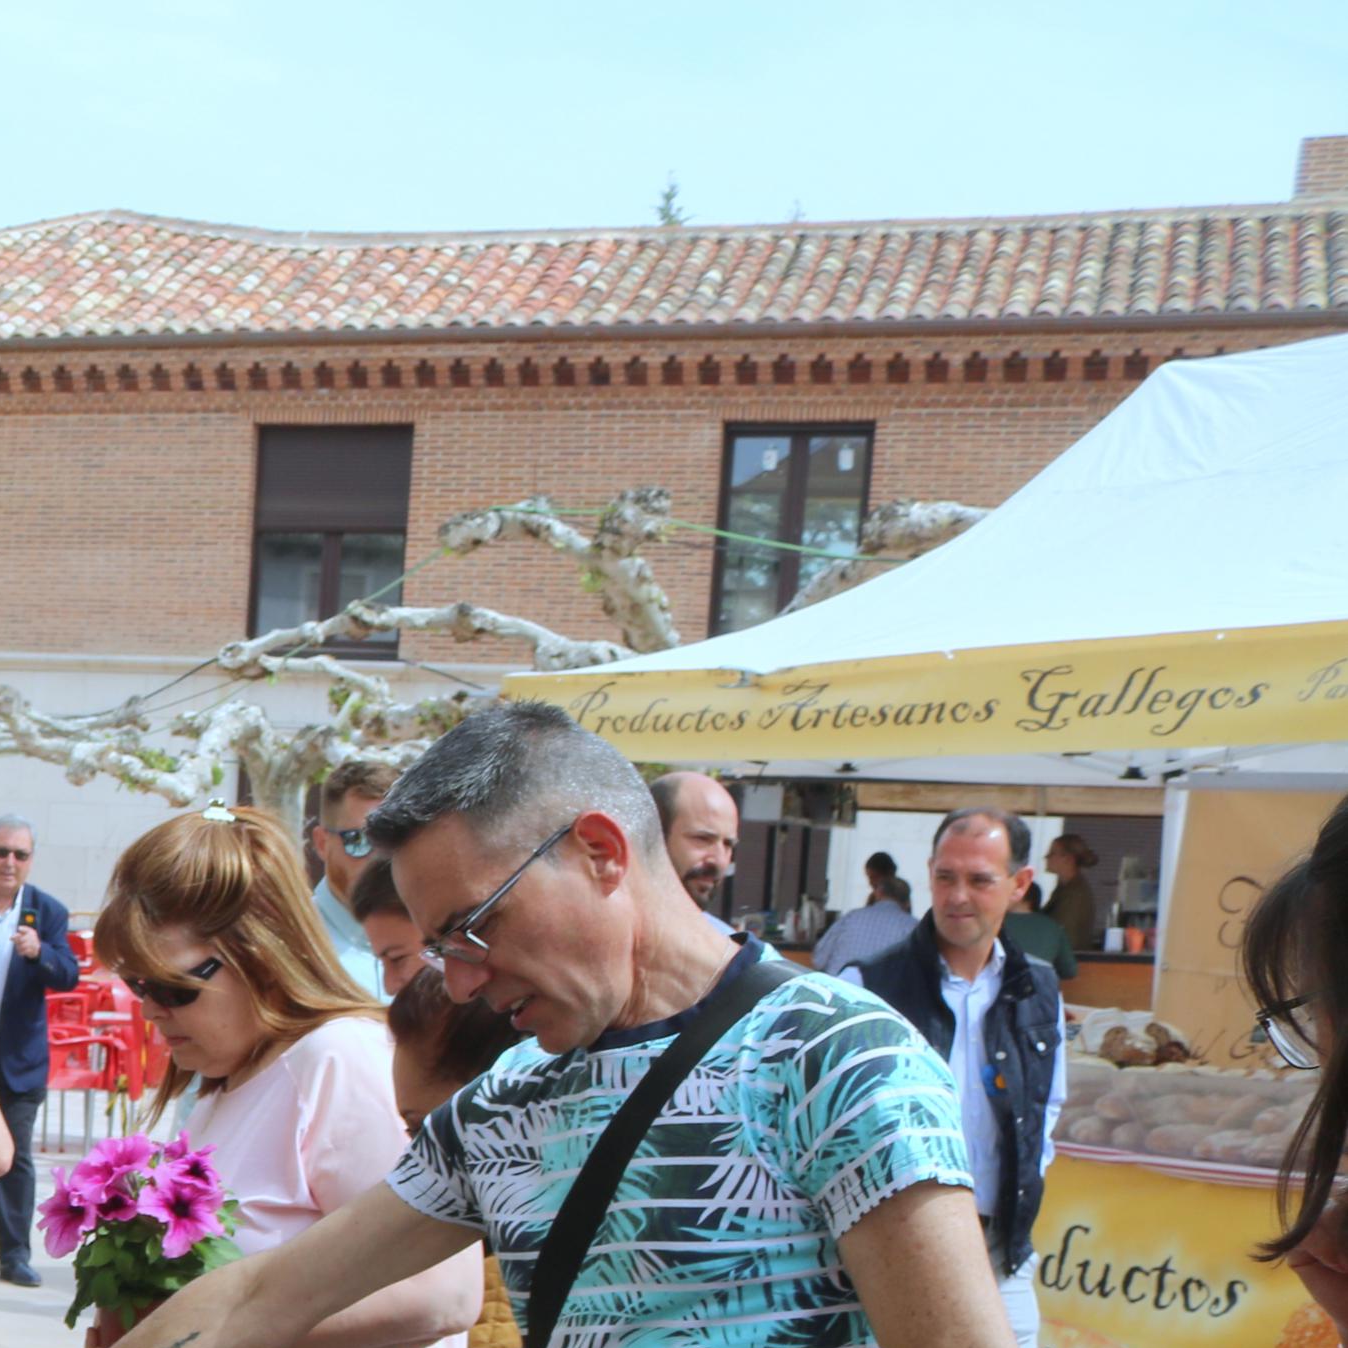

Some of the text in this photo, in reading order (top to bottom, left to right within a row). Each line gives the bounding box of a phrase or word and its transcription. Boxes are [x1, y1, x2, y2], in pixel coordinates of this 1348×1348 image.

[569, 657, 1348, 736] Productos Artesanos Gallegos Pa
[1039, 1224, 1248, 1318] ductos
